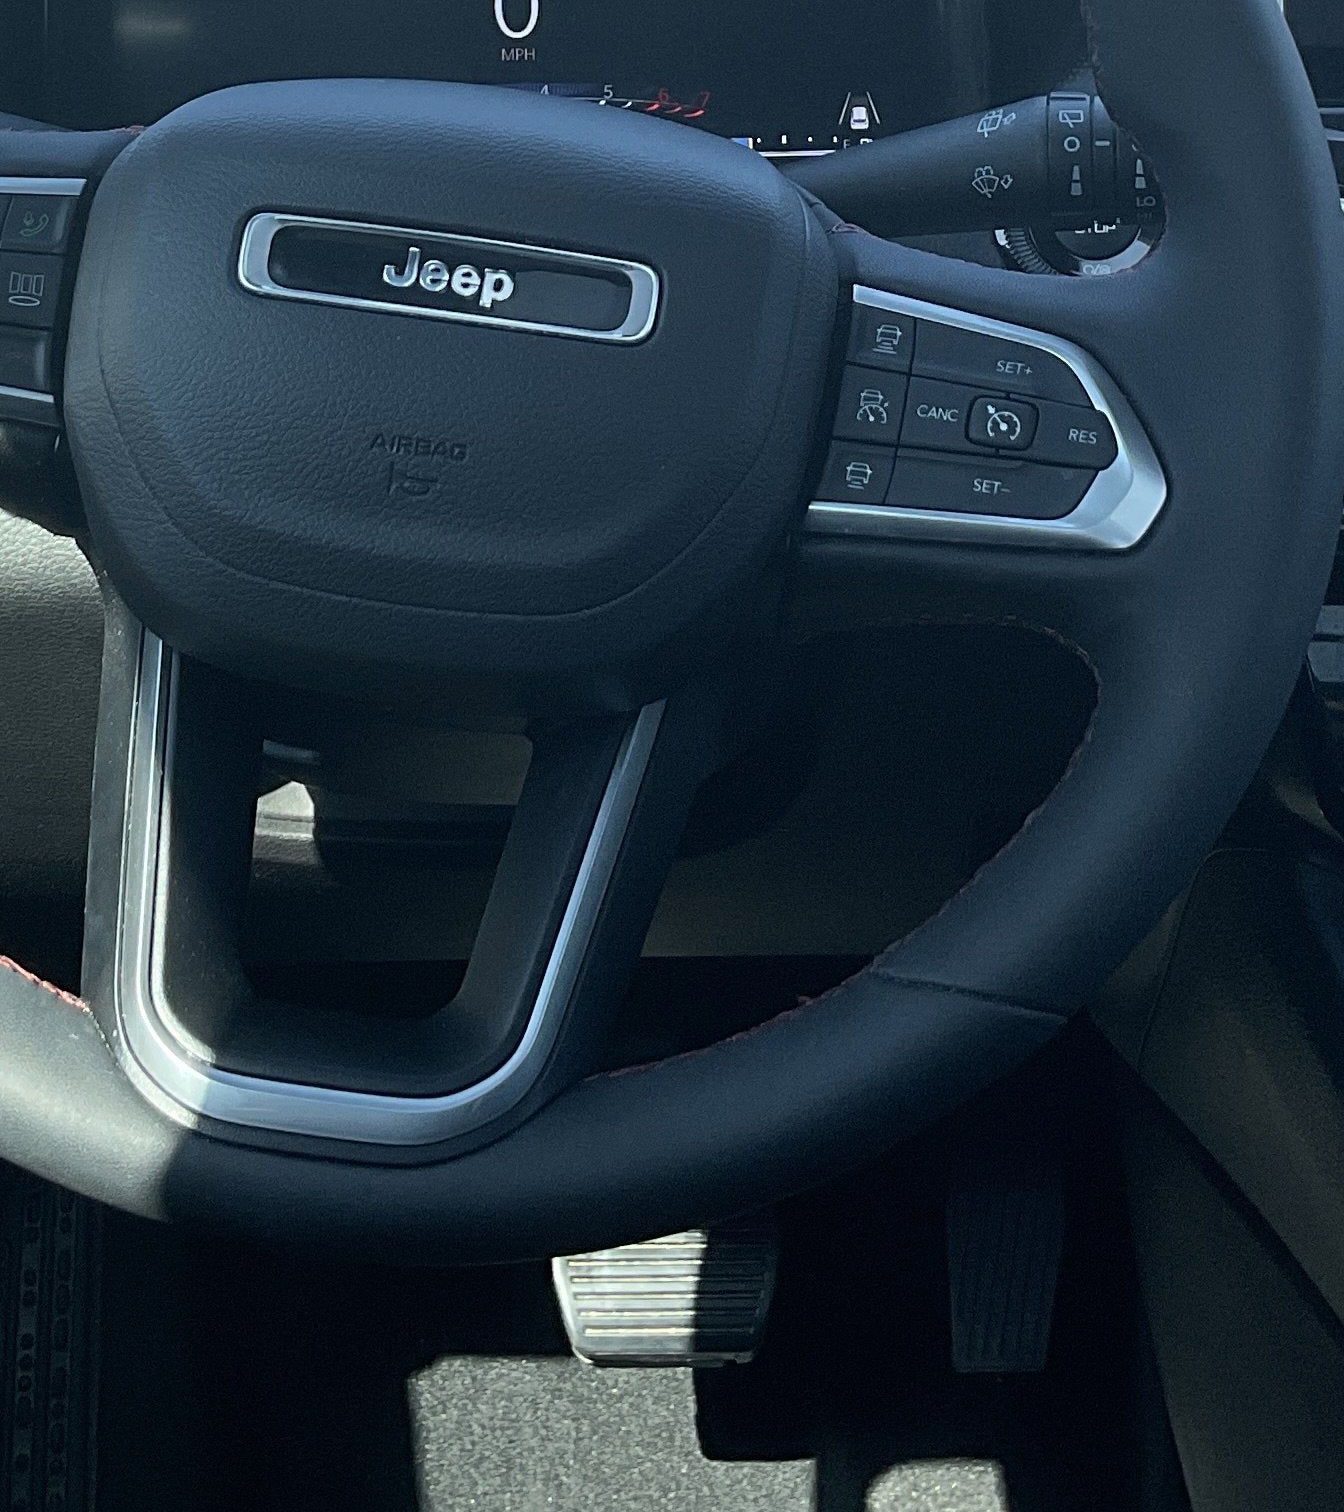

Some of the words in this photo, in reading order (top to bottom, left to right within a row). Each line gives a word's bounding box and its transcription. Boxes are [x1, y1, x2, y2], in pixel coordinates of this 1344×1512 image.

[500, 47, 536, 62] MPH
[382, 246, 514, 308] Jeep
[996, 360, 1033, 376] SET+
[916, 405, 959, 423] CANC
[1068, 428, 1097, 445] RES
[368, 432, 470, 462] AIRBAG
